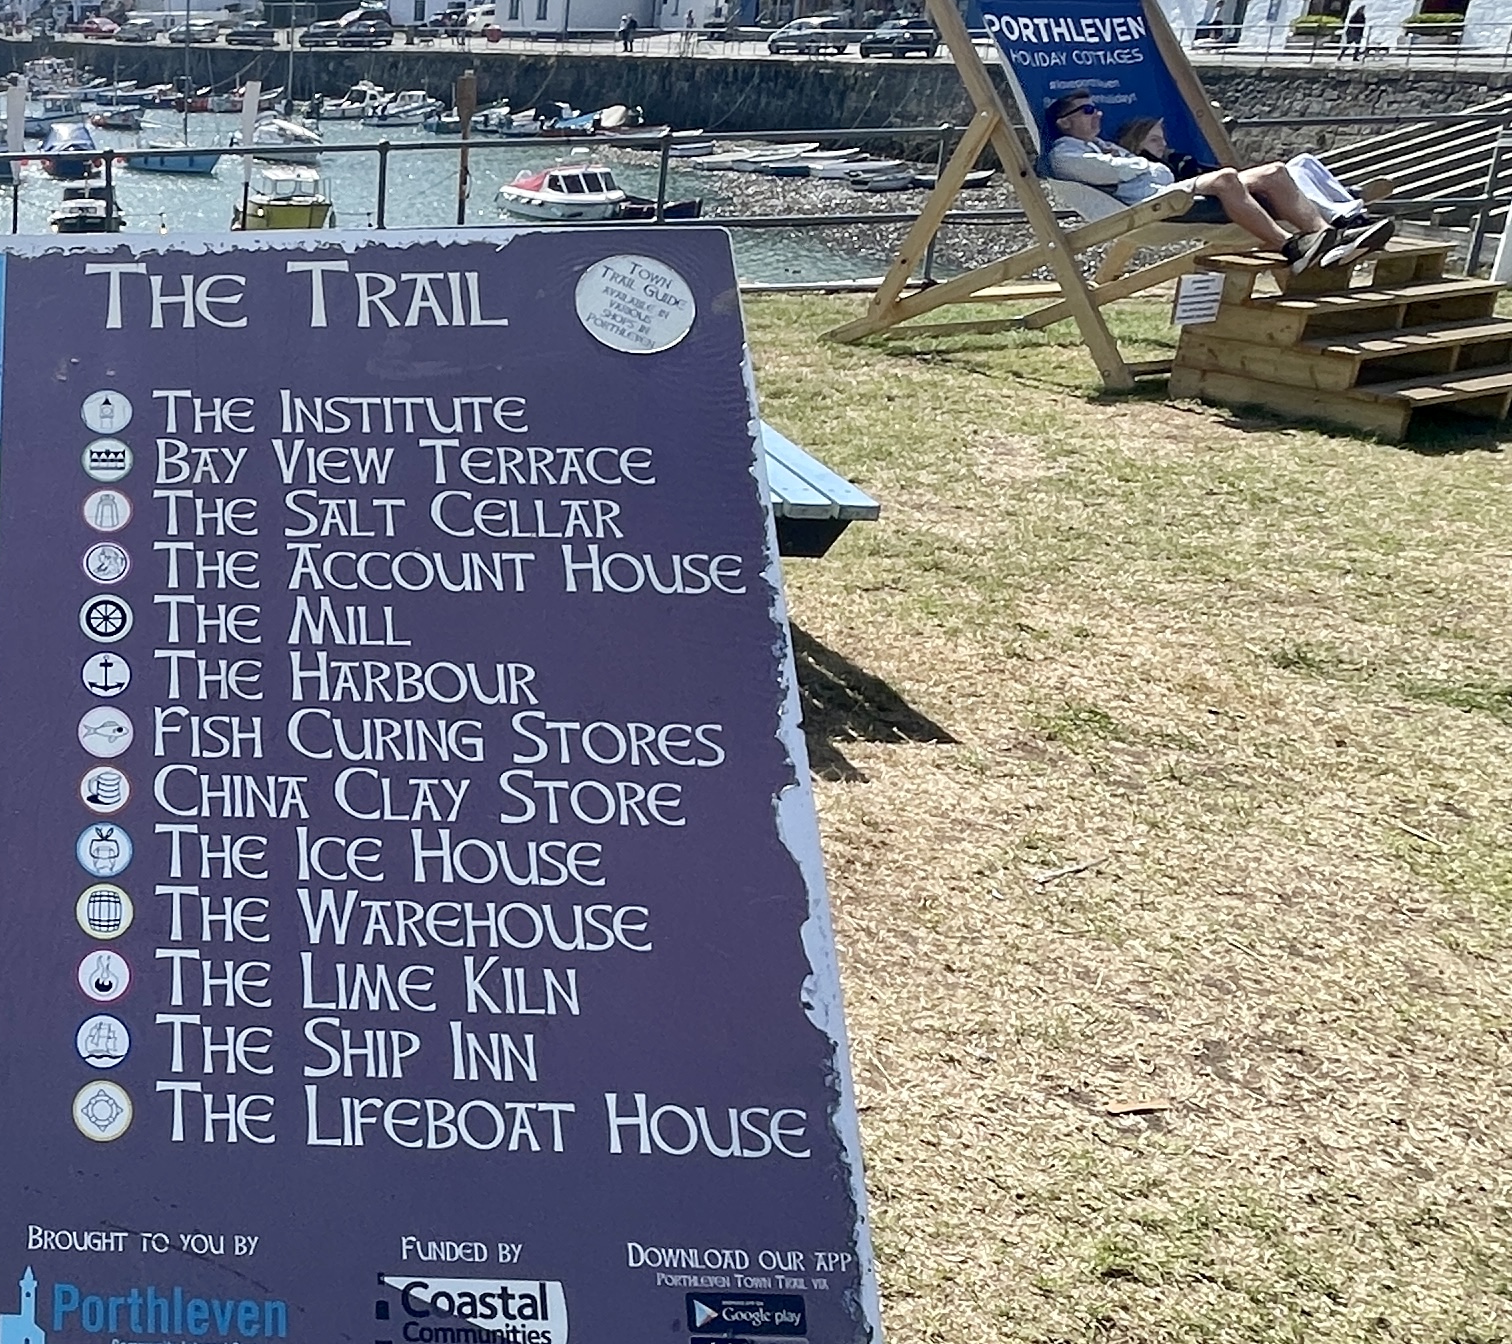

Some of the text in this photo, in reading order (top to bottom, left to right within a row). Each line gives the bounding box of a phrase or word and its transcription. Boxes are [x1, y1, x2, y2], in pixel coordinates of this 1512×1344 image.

[983, 13, 1148, 44] PORTHLEVEN
[1009, 47, 1145, 68] HOLIDAY COTTAGES
[601, 265, 688, 312] TRAIL GUIDE
[629, 261, 673, 290] TOWN
[84, 260, 509, 329] THE TRAIL
[52, 1282, 288, 1338] Porthleven
[400, 1280, 549, 1321] Coastal
[721, 1306, 802, 1327] Google play
